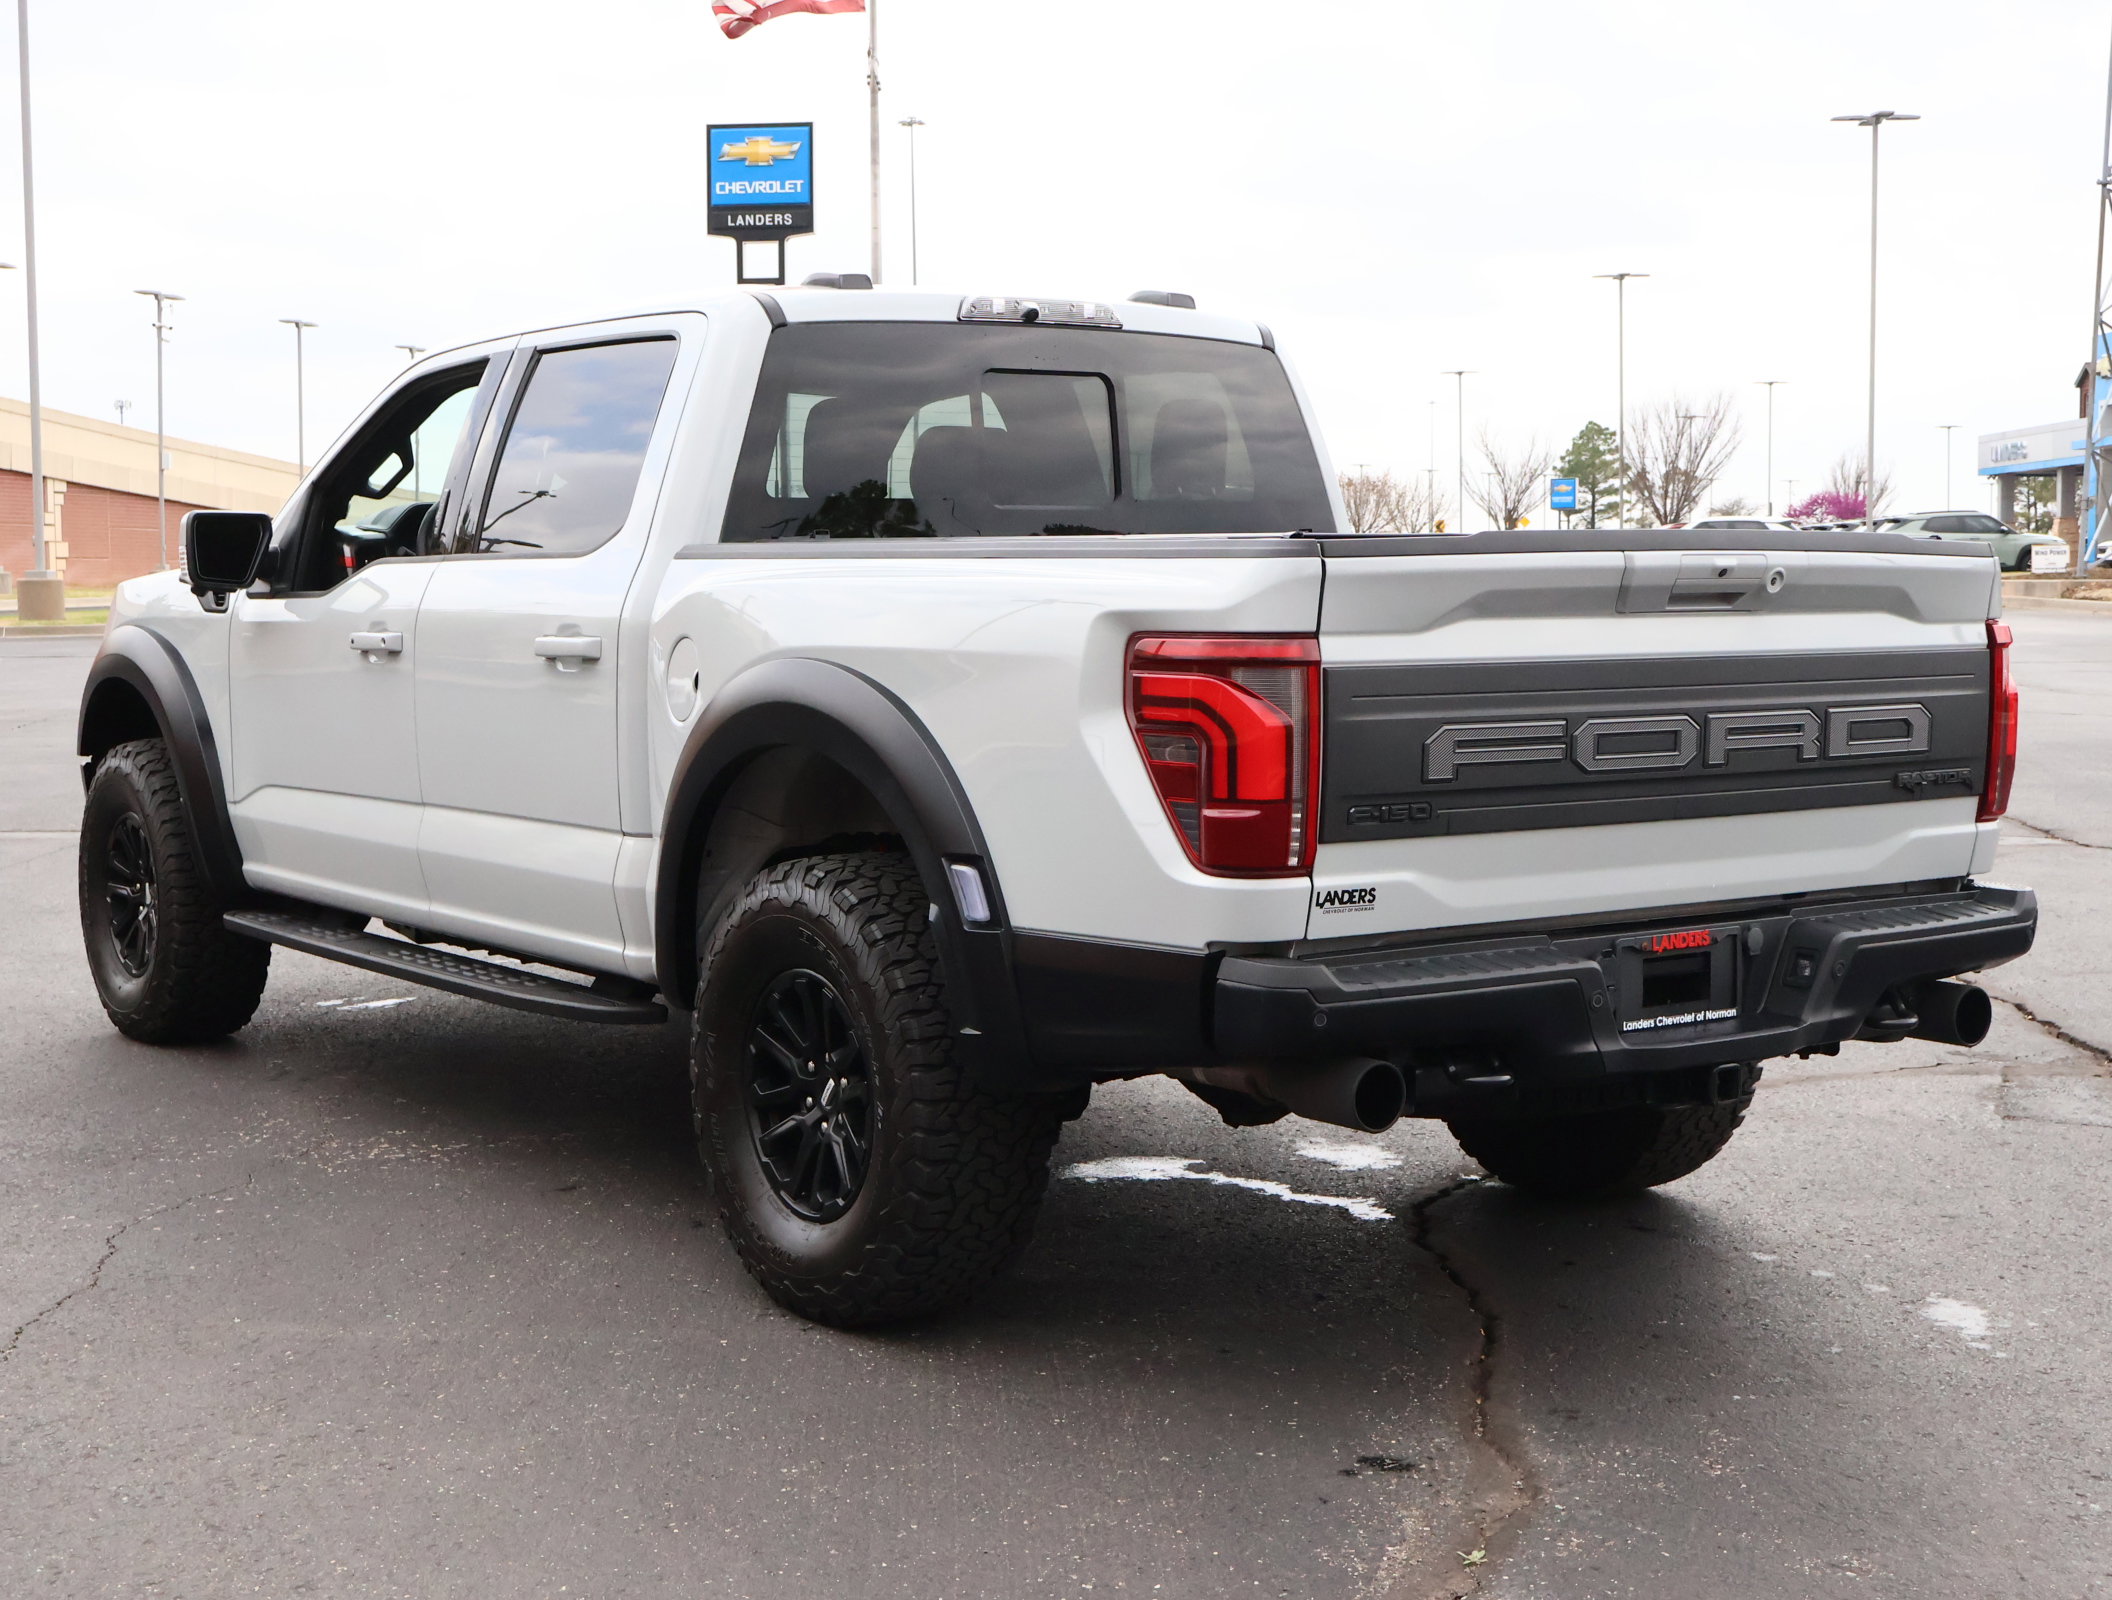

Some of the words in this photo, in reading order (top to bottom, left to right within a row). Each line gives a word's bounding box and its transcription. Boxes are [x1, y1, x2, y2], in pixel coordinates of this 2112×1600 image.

[715, 179, 804, 194] CHEVROLET
[727, 213, 793, 227] LANDERS
[1421, 702, 1933, 784] FORD
[1315, 887, 1377, 909] LANDERS
[1652, 929, 1711, 953] LANDERS
[1623, 1018, 1655, 1031] Landers
[1656, 1012, 1695, 1027] Chevrolet
[1696, 1010, 1704, 1021] of
[1706, 1008, 1737, 1021] Norman
